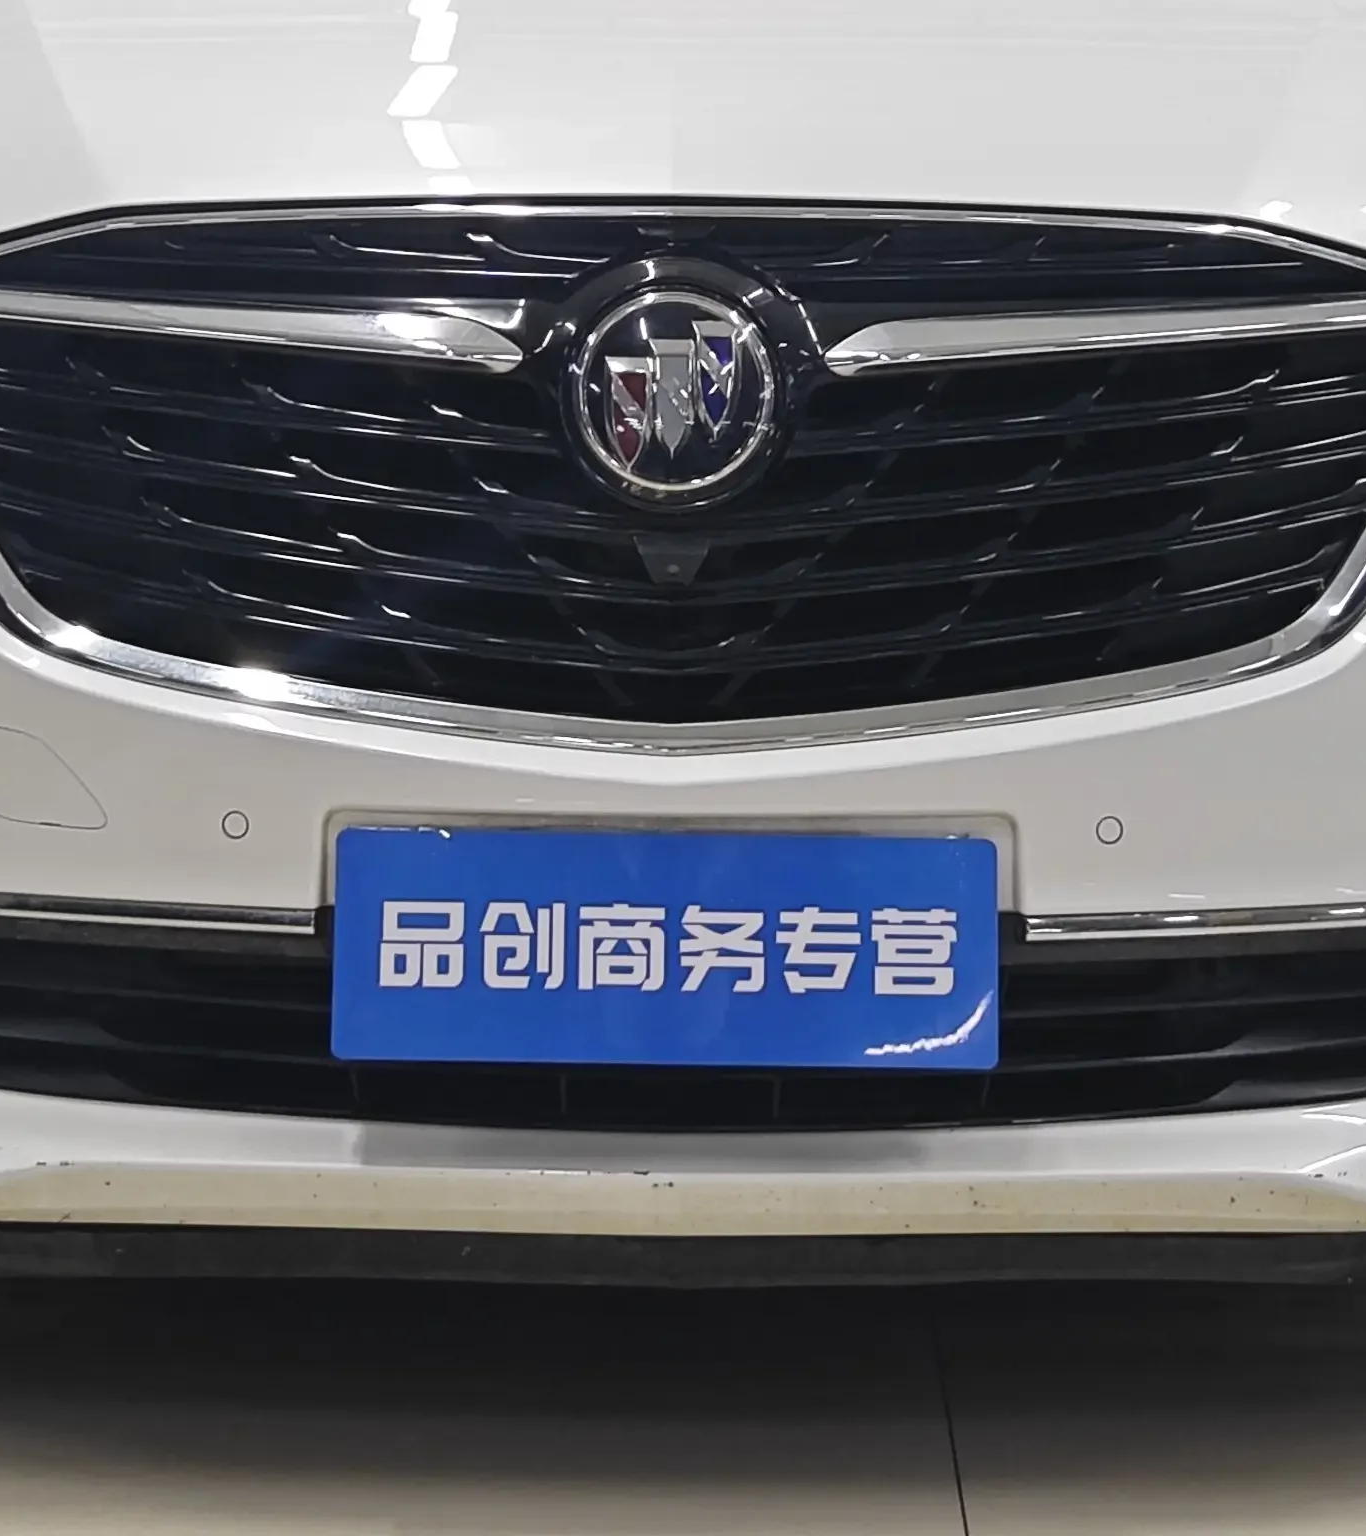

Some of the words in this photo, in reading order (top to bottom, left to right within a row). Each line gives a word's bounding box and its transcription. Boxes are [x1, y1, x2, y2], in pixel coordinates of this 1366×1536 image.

[380, 902, 956, 994] 品创商务专营
